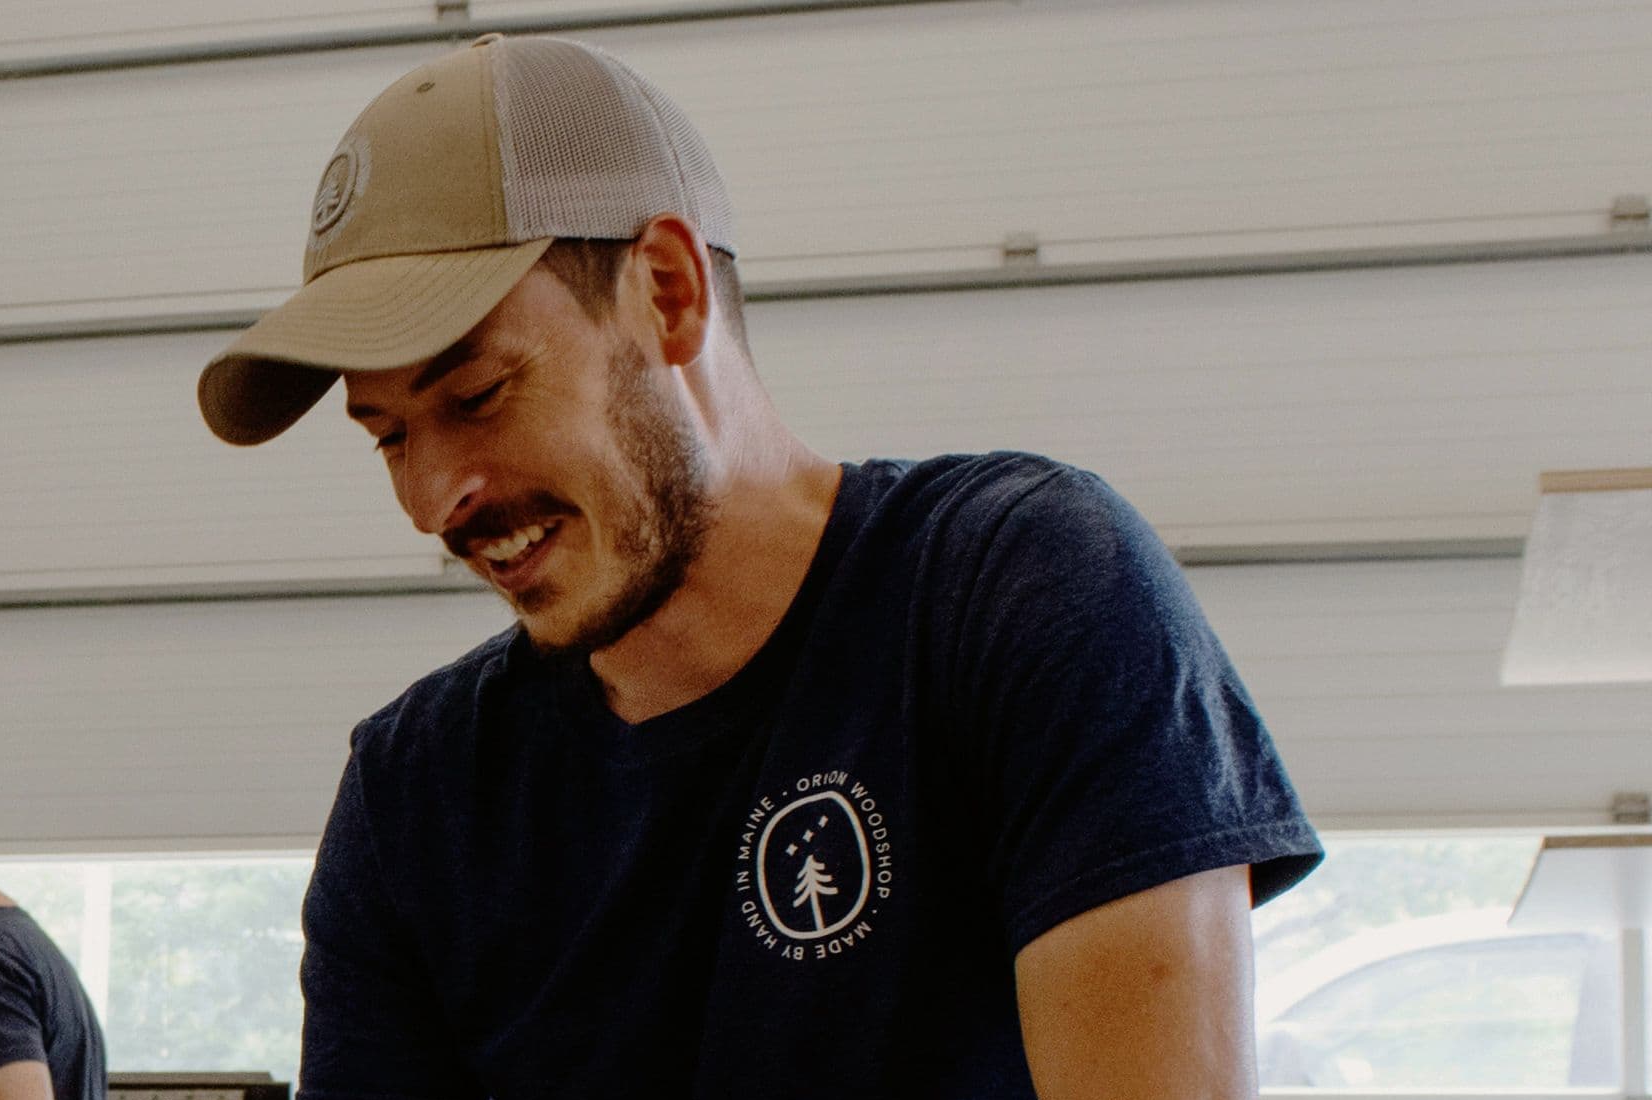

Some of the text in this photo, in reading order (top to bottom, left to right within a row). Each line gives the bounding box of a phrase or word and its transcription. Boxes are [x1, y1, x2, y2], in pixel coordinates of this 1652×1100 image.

[737, 796, 874, 961] MADE BY HAND IN MAINE
[796, 770, 892, 900] ORION WOODSHOP
